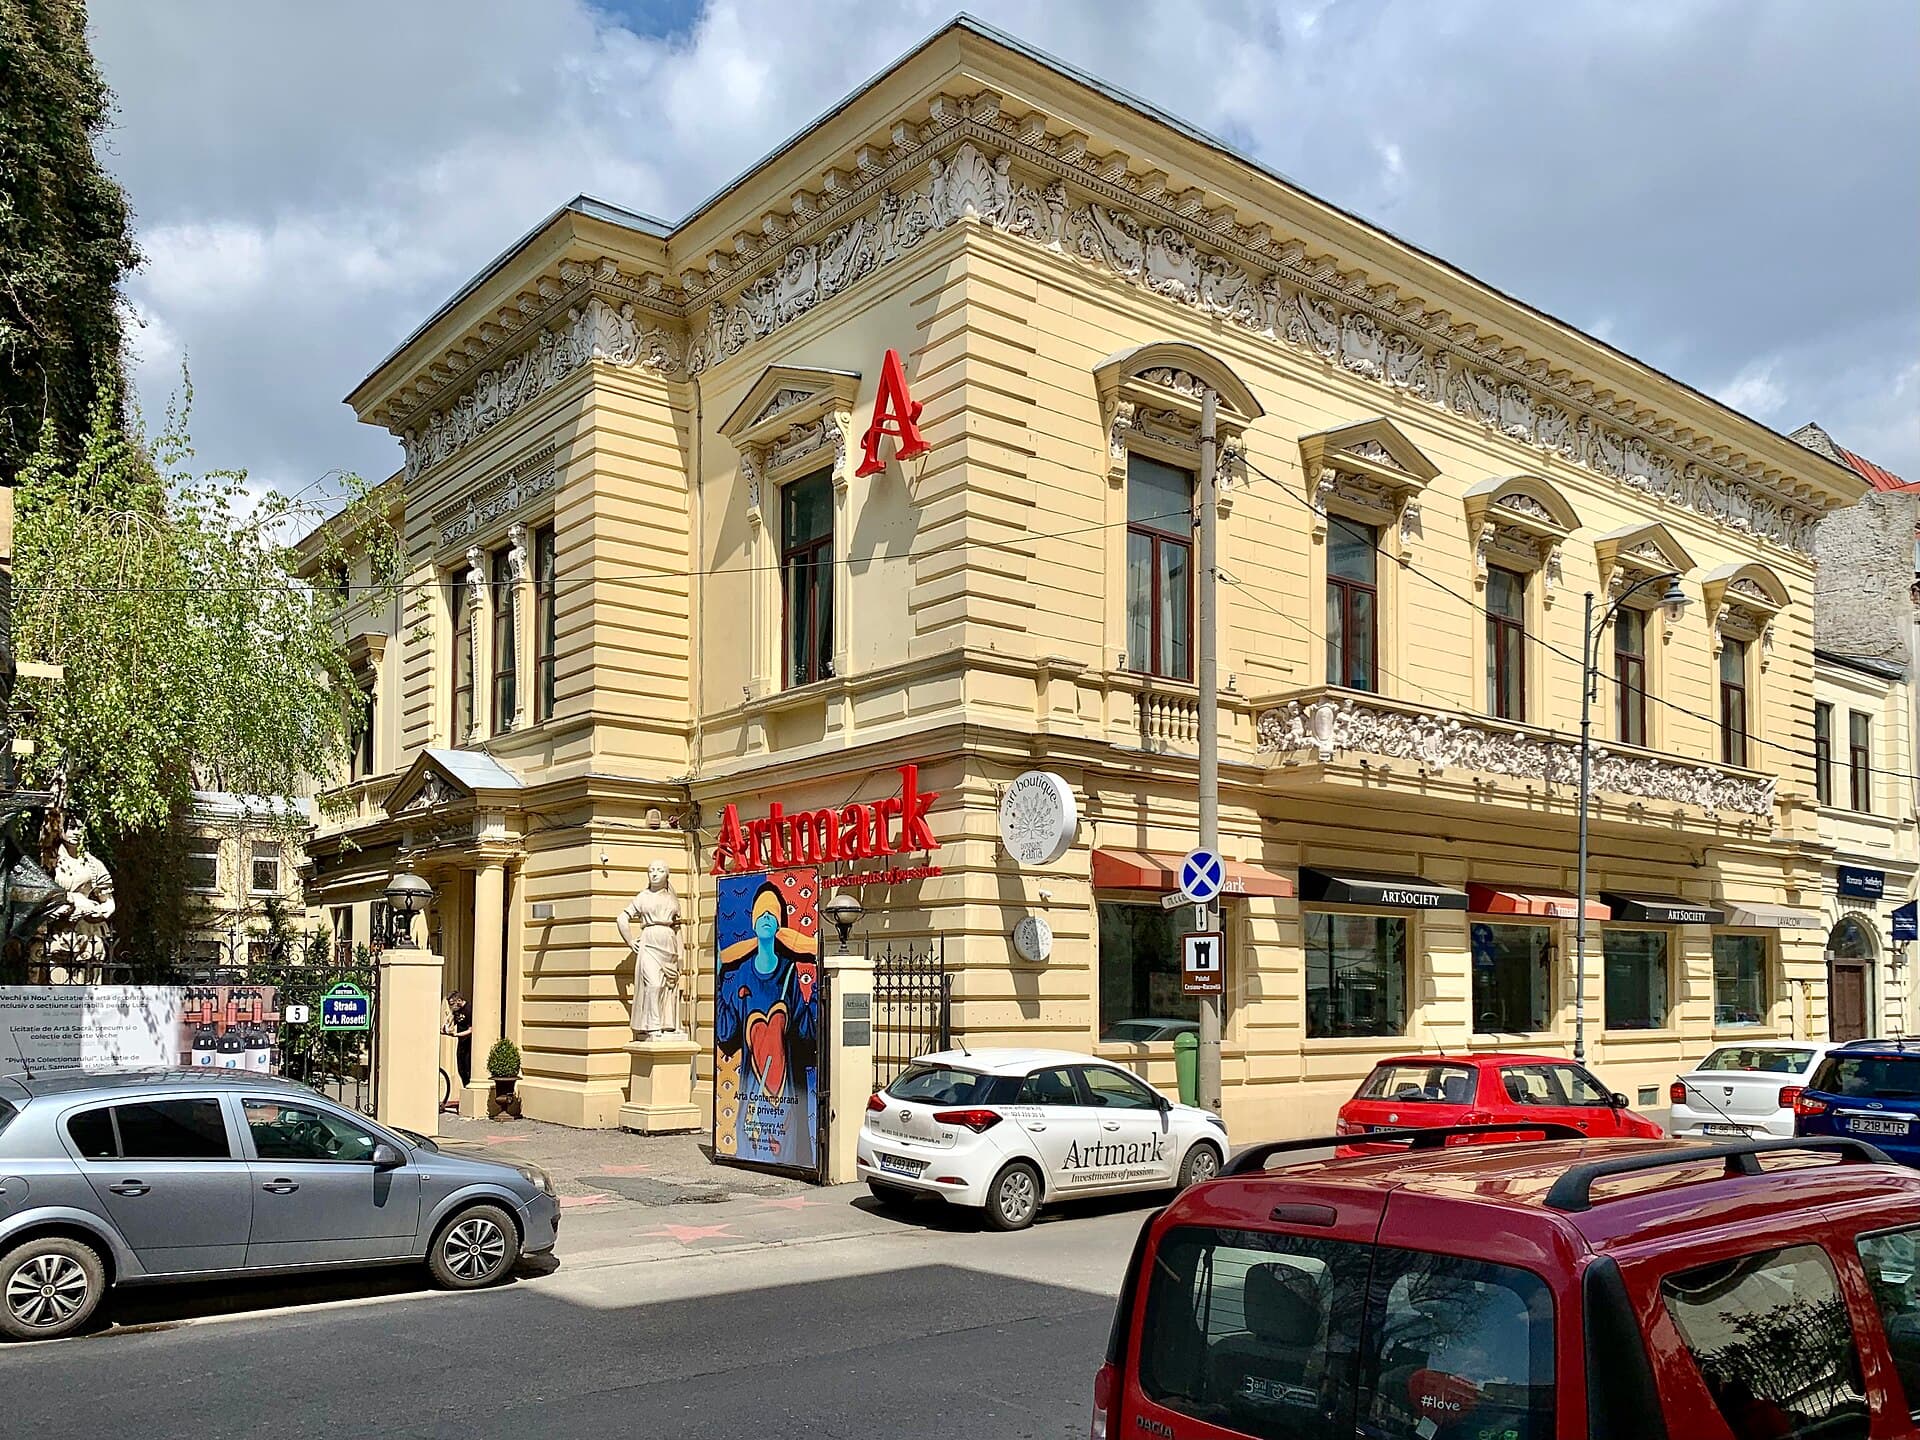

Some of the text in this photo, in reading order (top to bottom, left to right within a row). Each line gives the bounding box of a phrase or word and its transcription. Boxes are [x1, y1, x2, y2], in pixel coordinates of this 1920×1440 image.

[855, 348, 931, 478] A
[1006, 775, 1057, 808] art boutique
[709, 764, 942, 875] Artmark
[294, 1007, 301, 1021] 5
[333, 1000, 358, 1012] Strada
[324, 1014, 366, 1025] C.A. Rosetti
[1852, 1120, 1905, 1133] B 218 MTR
[1062, 1132, 1164, 1170] Artmark
[885, 1156, 891, 1167] B
[893, 1158, 905, 1170] 493
[906, 1161, 920, 1173] ART
[1071, 1167, 1154, 1183] Investments of passion
[1245, 1376, 1254, 1393] 3
[1420, 1394, 1460, 1411] #love
[1136, 1414, 1172, 1440] DACIA
